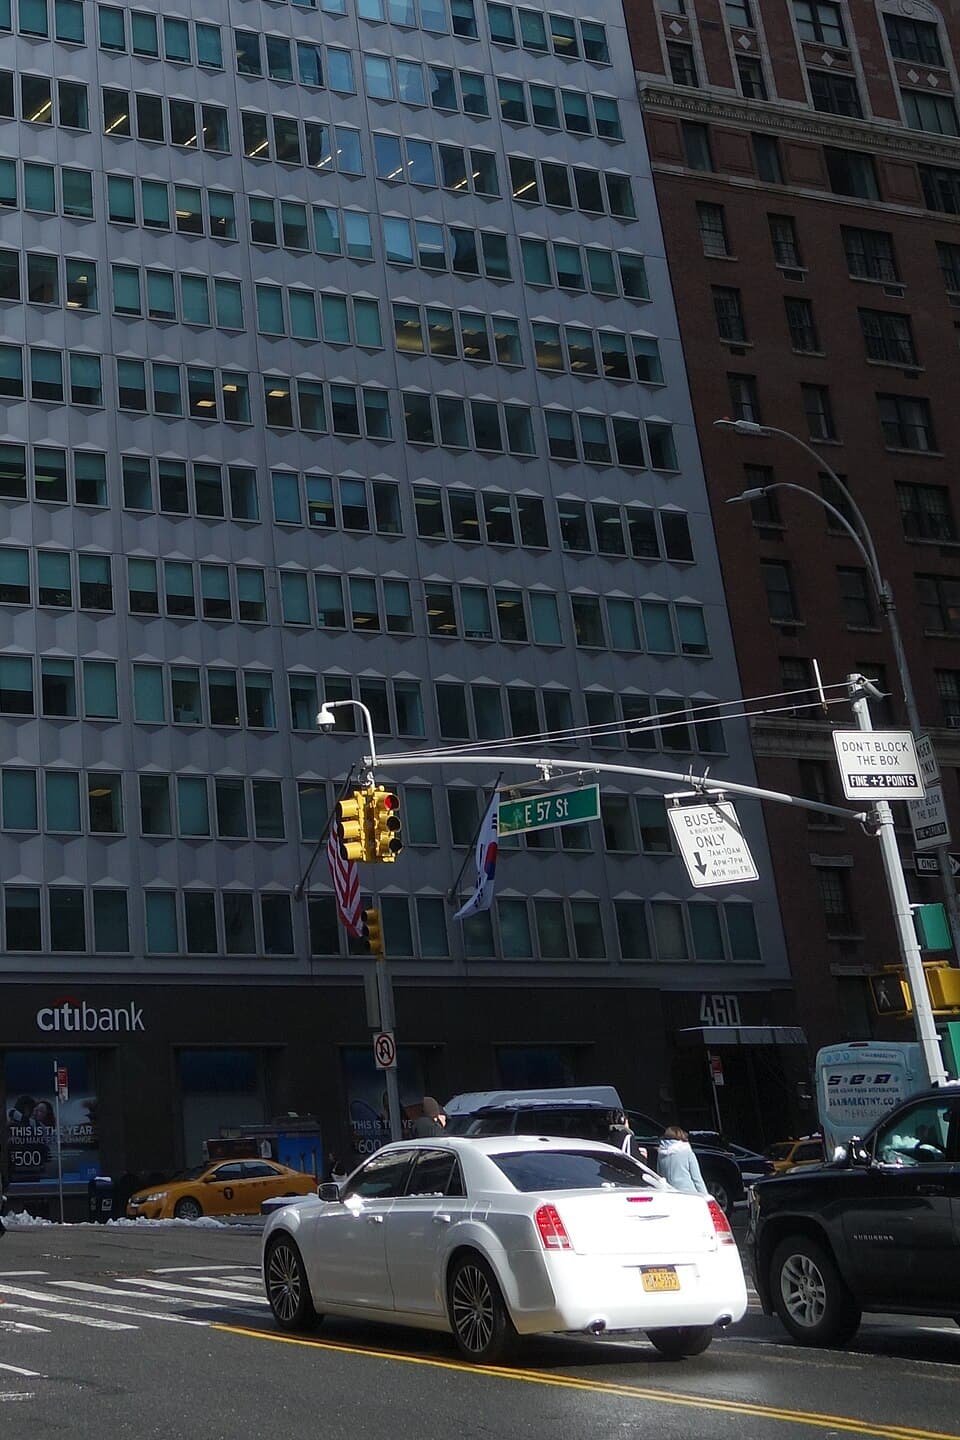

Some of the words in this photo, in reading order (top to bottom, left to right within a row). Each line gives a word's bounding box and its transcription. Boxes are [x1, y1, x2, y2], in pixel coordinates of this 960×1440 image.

[842, 742, 871, 752] DON'T
[875, 741, 909, 752] BLOCK
[857, 755, 877, 766] THE
[880, 755, 900, 766] BOX
[850, 776, 869, 786] FINE
[871, 776, 885, 786] +2
[886, 775, 915, 786] POINTS
[525, 804, 532, 824] E
[537, 801, 551, 821] 57
[556, 798, 568, 817] St
[684, 812, 724, 827] BUSES
[696, 833, 725, 848] ONLY
[707, 847, 740, 857] 7AM-10AM
[713, 858, 743, 866] 4PM-7PM
[37, 1001, 145, 1031] citibank
[700, 995, 741, 1026] 460
[10, 1126, 32, 1136] THIS
[34, 1126, 43, 1136] IS
[68, 1125, 93, 1135] YEAR
